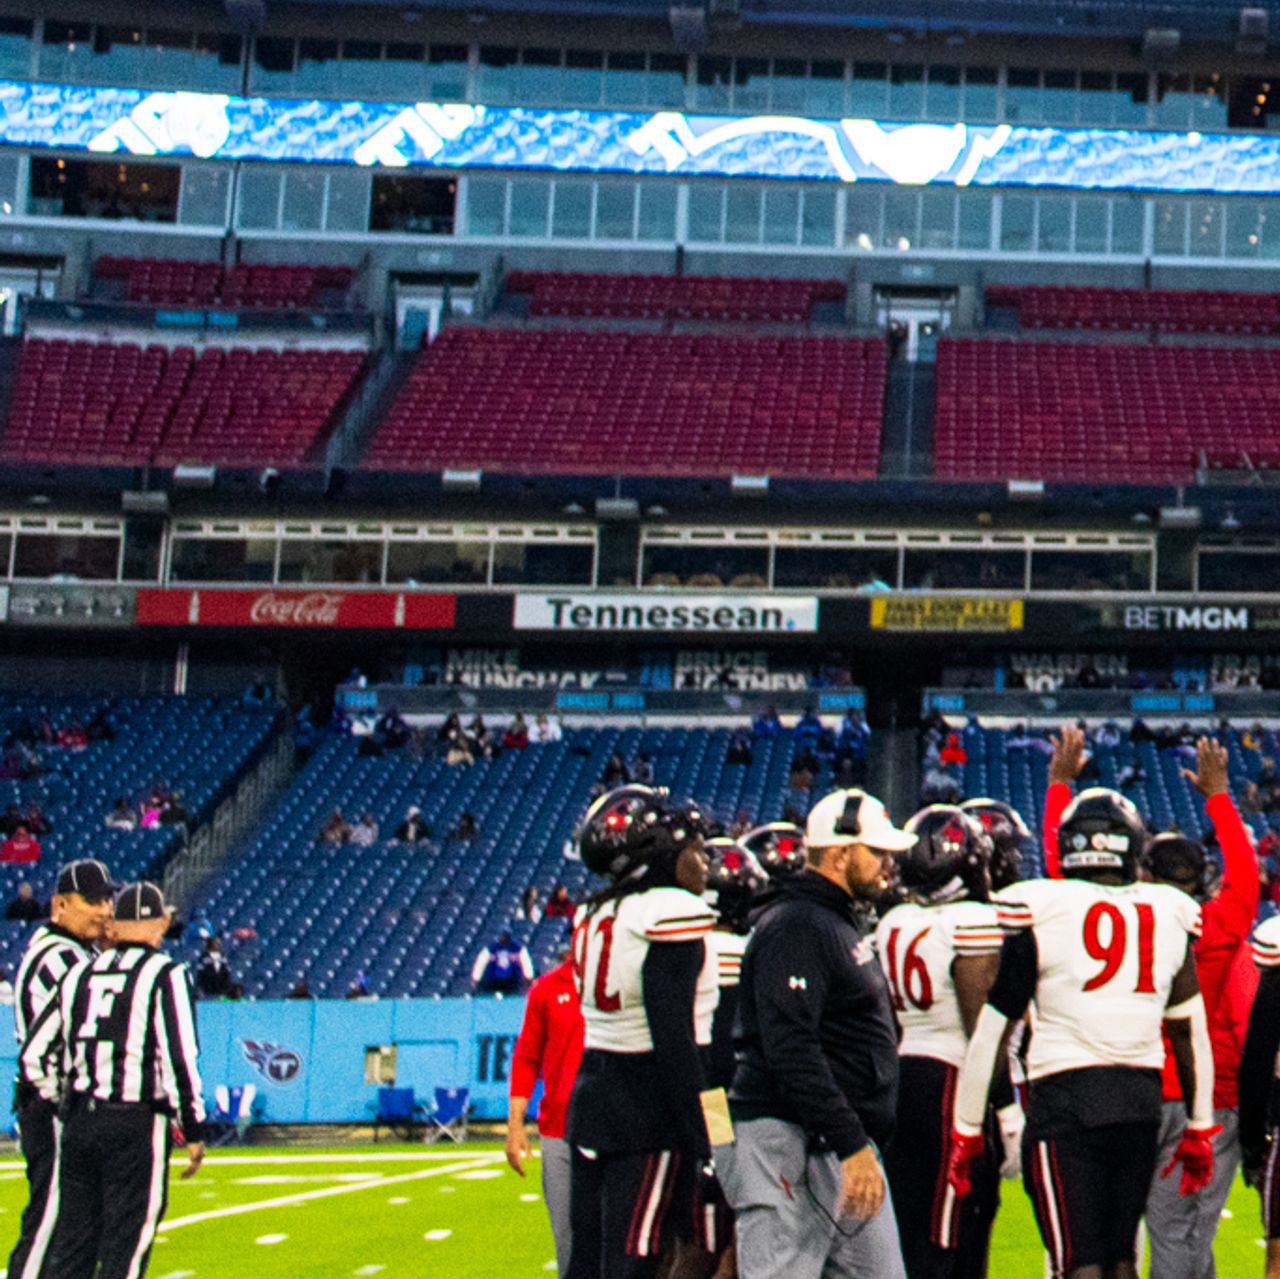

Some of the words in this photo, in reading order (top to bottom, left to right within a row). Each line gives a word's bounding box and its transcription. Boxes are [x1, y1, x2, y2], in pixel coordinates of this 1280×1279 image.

[547, 598, 784, 628] Tennessean
[1125, 606, 1249, 631] BETMGM
[886, 926, 933, 1012] 16
[1081, 900, 1157, 993] 91
[77, 973, 128, 1039] F
